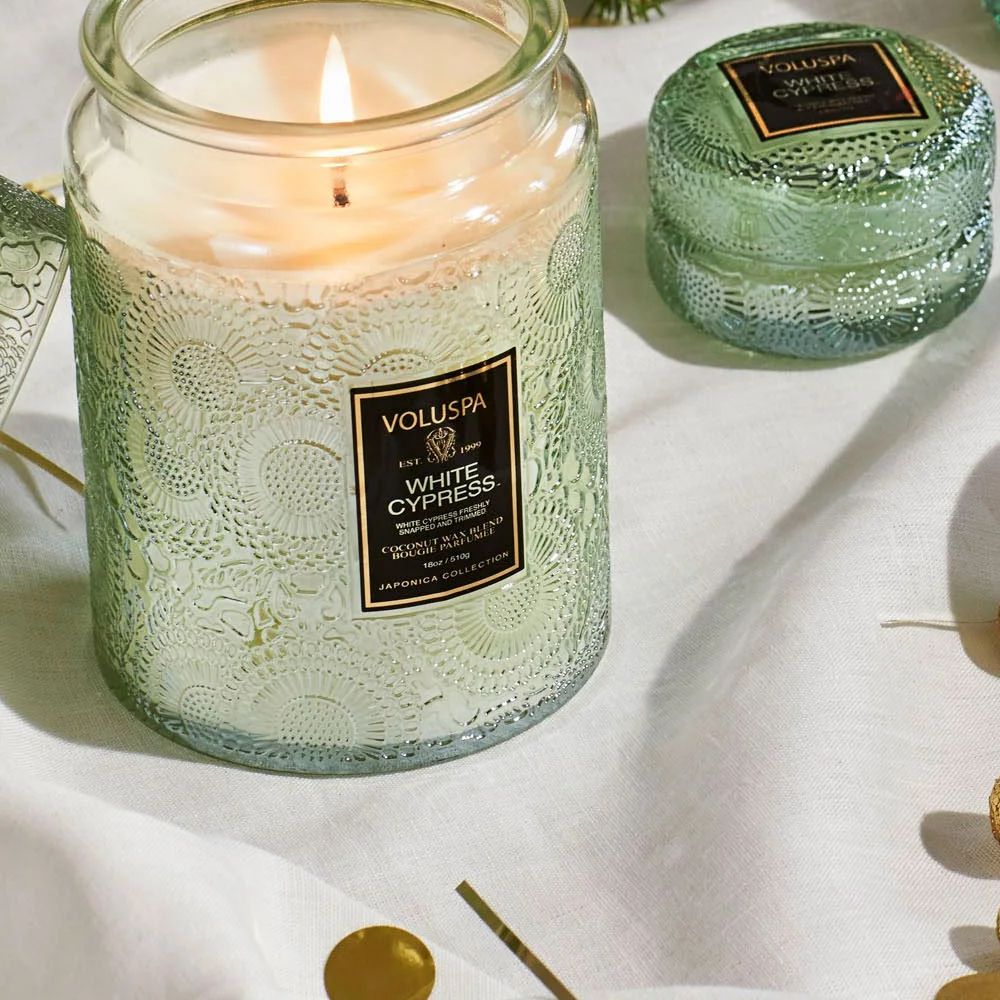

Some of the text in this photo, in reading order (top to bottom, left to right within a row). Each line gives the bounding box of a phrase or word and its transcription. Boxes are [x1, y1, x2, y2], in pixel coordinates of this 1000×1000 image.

[759, 53, 857, 75] VOLUSPA
[382, 392, 487, 433] VOLUSPA
[405, 461, 479, 495] WHITE
[388, 474, 496, 516] CYPRESS
[395, 499, 491, 530] WHITE CYPRESS FRESHLY
[398, 507, 487, 536] SNAPPED AND TRIMMED
[381, 516, 504, 554] COCONUT WAX BLEND
[392, 545, 437, 560] BOUGIE
[423, 559, 443, 569] 18oz
[450, 552, 471, 563] 510g
[379, 551, 510, 591] JAPONICA COLLECTION
